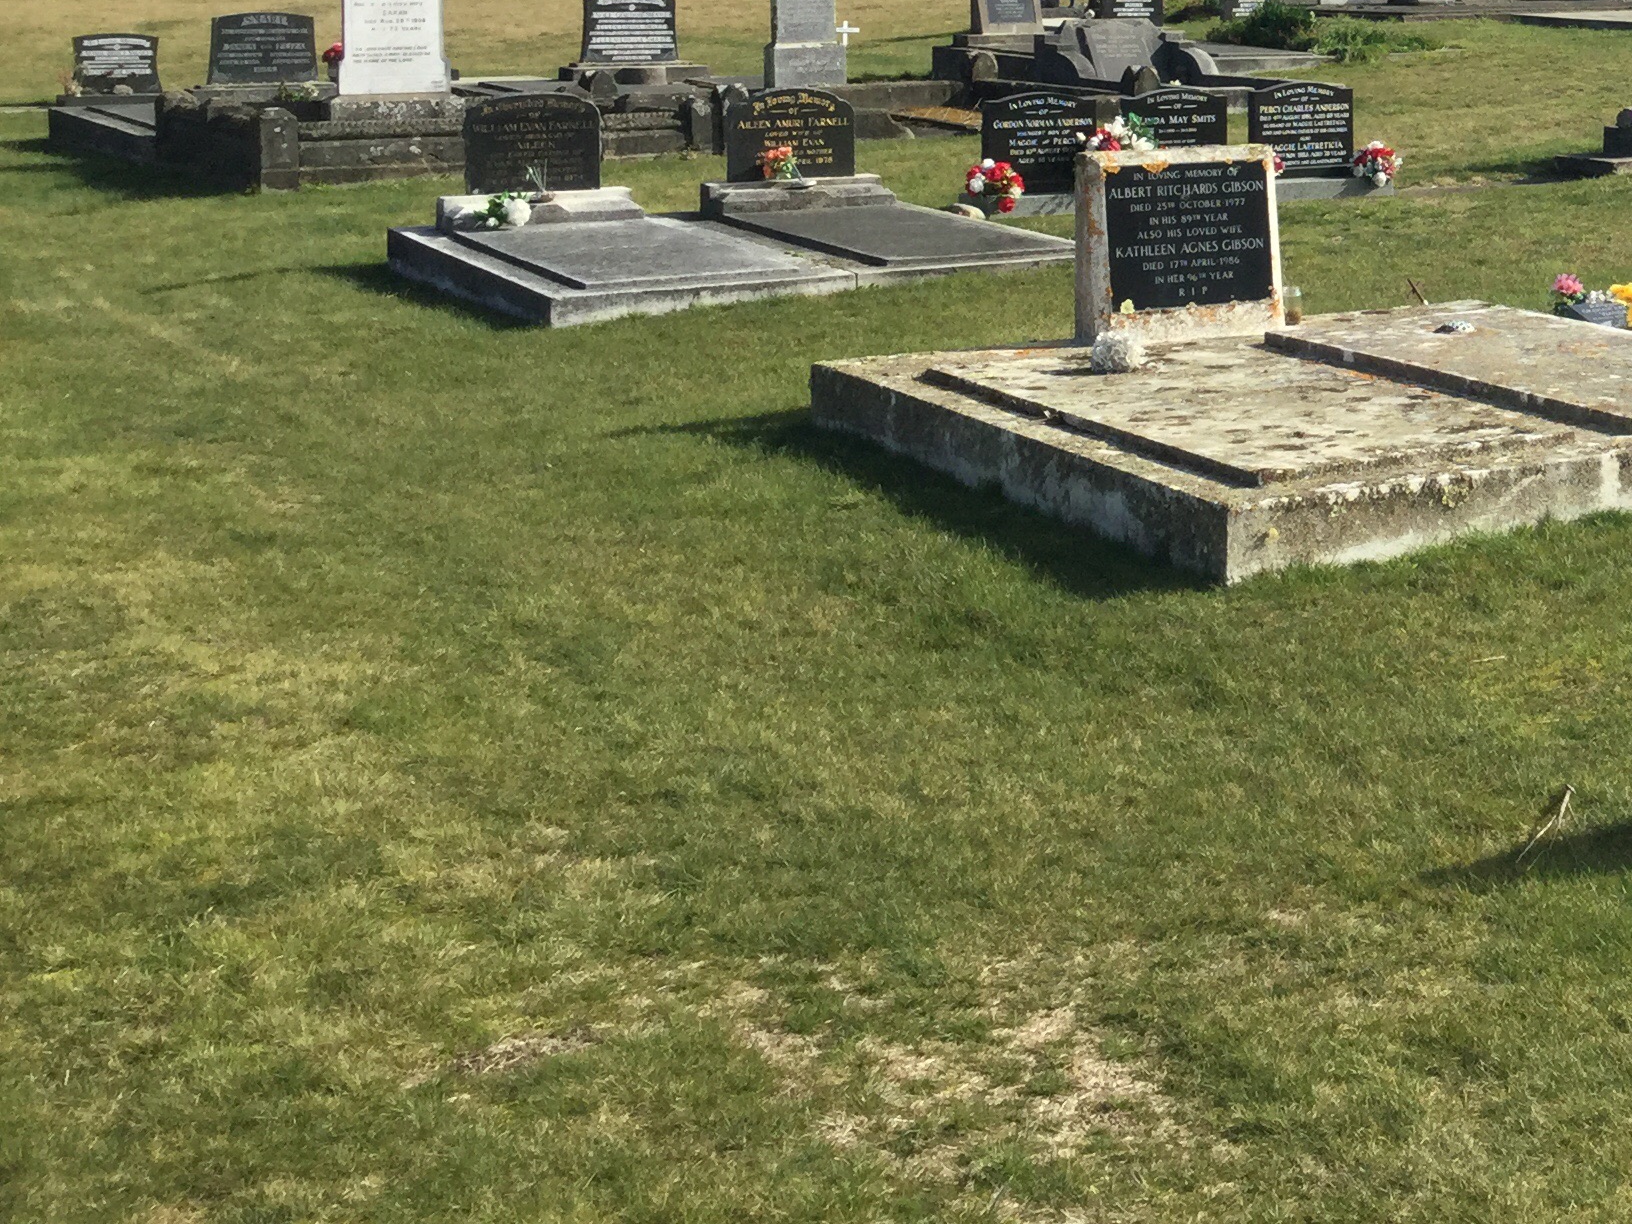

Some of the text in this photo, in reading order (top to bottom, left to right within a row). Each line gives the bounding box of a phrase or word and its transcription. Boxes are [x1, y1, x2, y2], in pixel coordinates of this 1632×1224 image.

[1147, 93, 1208, 104] IN LOVING MEMORY
[1282, 87, 1306, 97] LOVING
[1307, 86, 1334, 96] MEMORY
[765, 95, 796, 108] Loving
[797, 93, 836, 112] Memory
[1009, 97, 1078, 111] IN LOVING MEMORY
[1259, 105, 1281, 113] PERCY
[1315, 103, 1349, 111] ANDERSON
[737, 120, 771, 129] AILEEN
[808, 117, 849, 127] FARNELL
[993, 117, 1093, 129] GORDON NORMAN ANDERSON
[1169, 114, 1216, 124] MAY SMITS
[472, 120, 595, 133] WILLIAM EVAN FARNELL
[764, 138, 825, 147] WILLIAM EVAN
[1133, 166, 1238, 181] IN LOVING MEMORY OF
[1108, 180, 1264, 200] ALBERT RITCHARDS GIBSON
[1130, 197, 1246, 213] DIED 25TH OCTOBER 1977
[1149, 212, 1229, 226] IN HIS 89TH YEAR
[1137, 225, 1242, 240] ALSO HIS LOVED WIFE
[1115, 237, 1264, 259] KATHLEEN AGNES GIBSON
[1142, 257, 1240, 271] DIED 17TH APRIL 1986
[1155, 276, 1164, 285] IN
[1167, 273, 1184, 284] HER
[1209, 271, 1234, 280] YEAR
[1178, 288, 1185, 297] R
[1202, 286, 1208, 295] P
